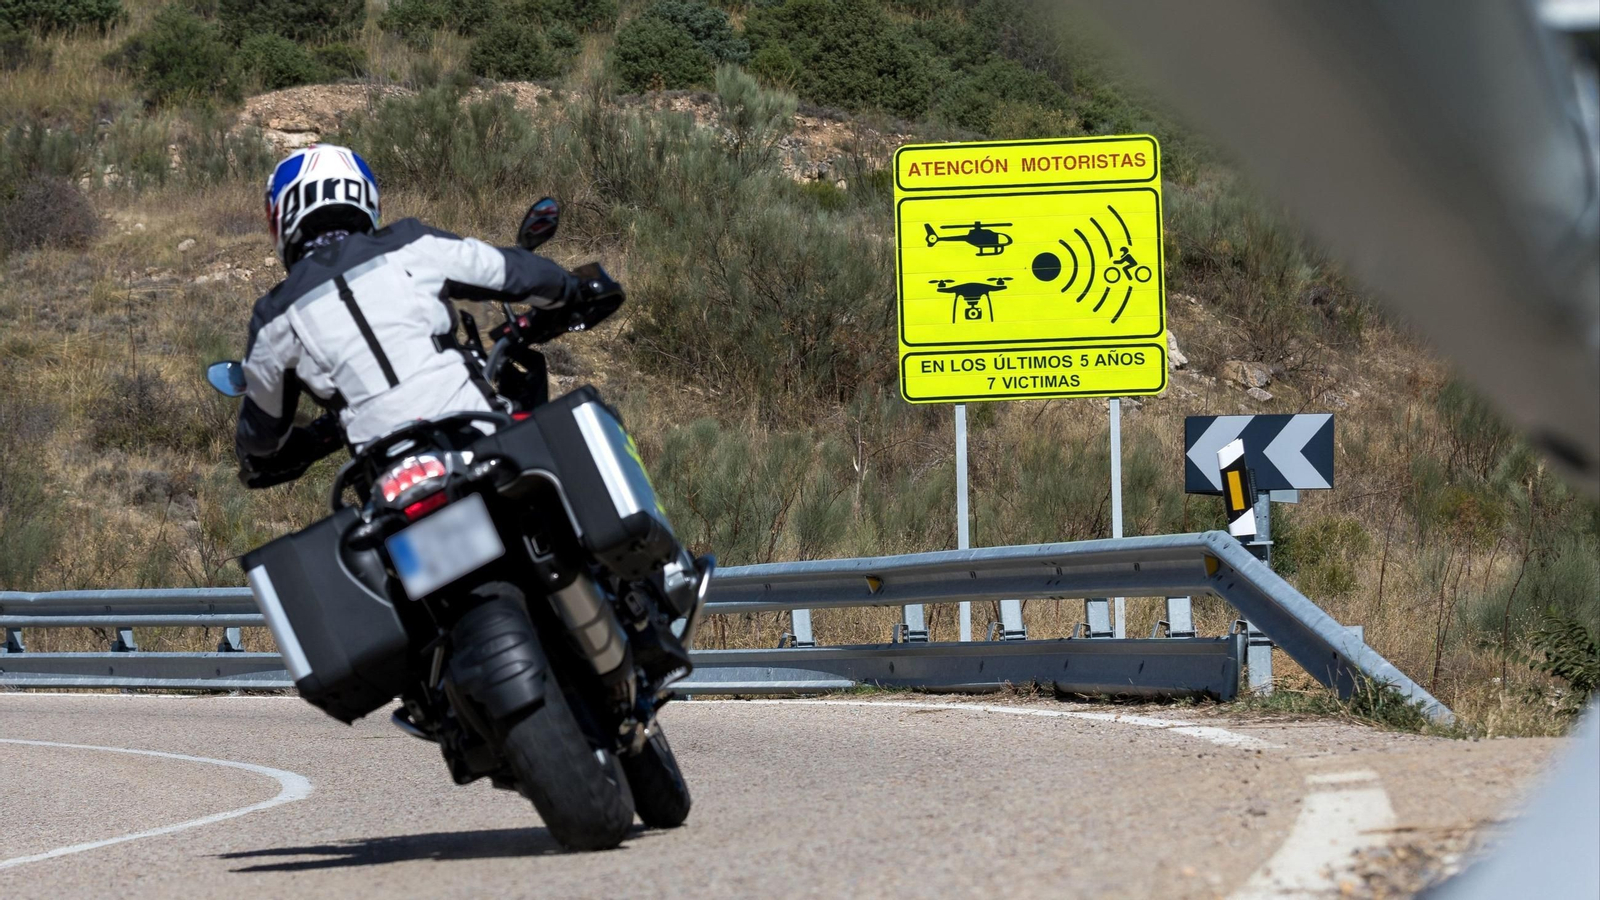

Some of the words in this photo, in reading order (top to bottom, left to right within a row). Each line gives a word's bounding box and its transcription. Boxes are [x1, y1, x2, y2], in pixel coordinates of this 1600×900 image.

[908, 155, 1008, 177] ATENCIÓN
[1021, 152, 1146, 172] MOTORISTAS
[921, 359, 945, 374] EN
[950, 357, 987, 372] LOS
[993, 353, 1073, 371] ÚLTIMOS
[1080, 354, 1089, 368] 5
[1094, 349, 1146, 367] AÑOS
[987, 377, 996, 390] 7
[1002, 374, 1081, 390] VICTIMAS
